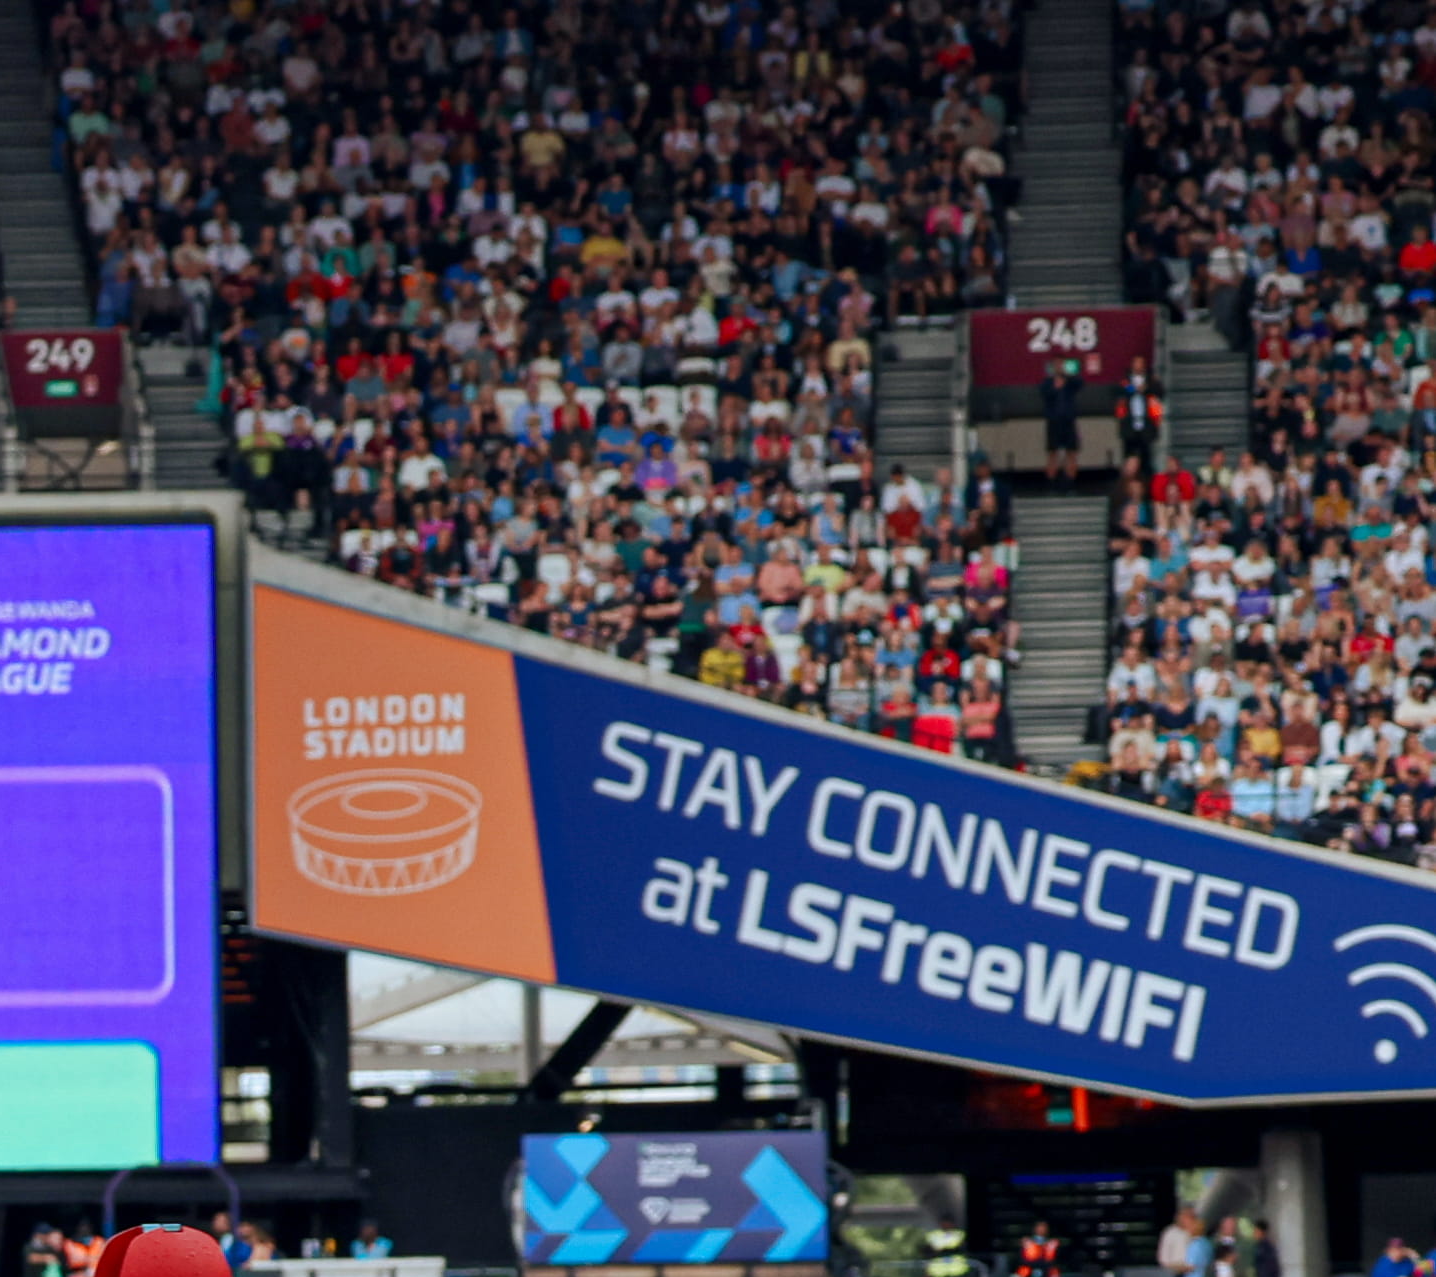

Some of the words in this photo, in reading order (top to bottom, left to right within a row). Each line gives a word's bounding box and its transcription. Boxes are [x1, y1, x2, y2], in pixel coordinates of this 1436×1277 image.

[1028, 316, 1098, 352] 248
[26, 337, 95, 373] 249
[302, 692, 467, 728] LONDON
[302, 724, 466, 761] STADIUM
[591, 718, 800, 837] STAY
[806, 775, 1300, 972] CONNECTED
[640, 856, 730, 935] at
[736, 868, 1208, 1065] LSFreeWIFI
